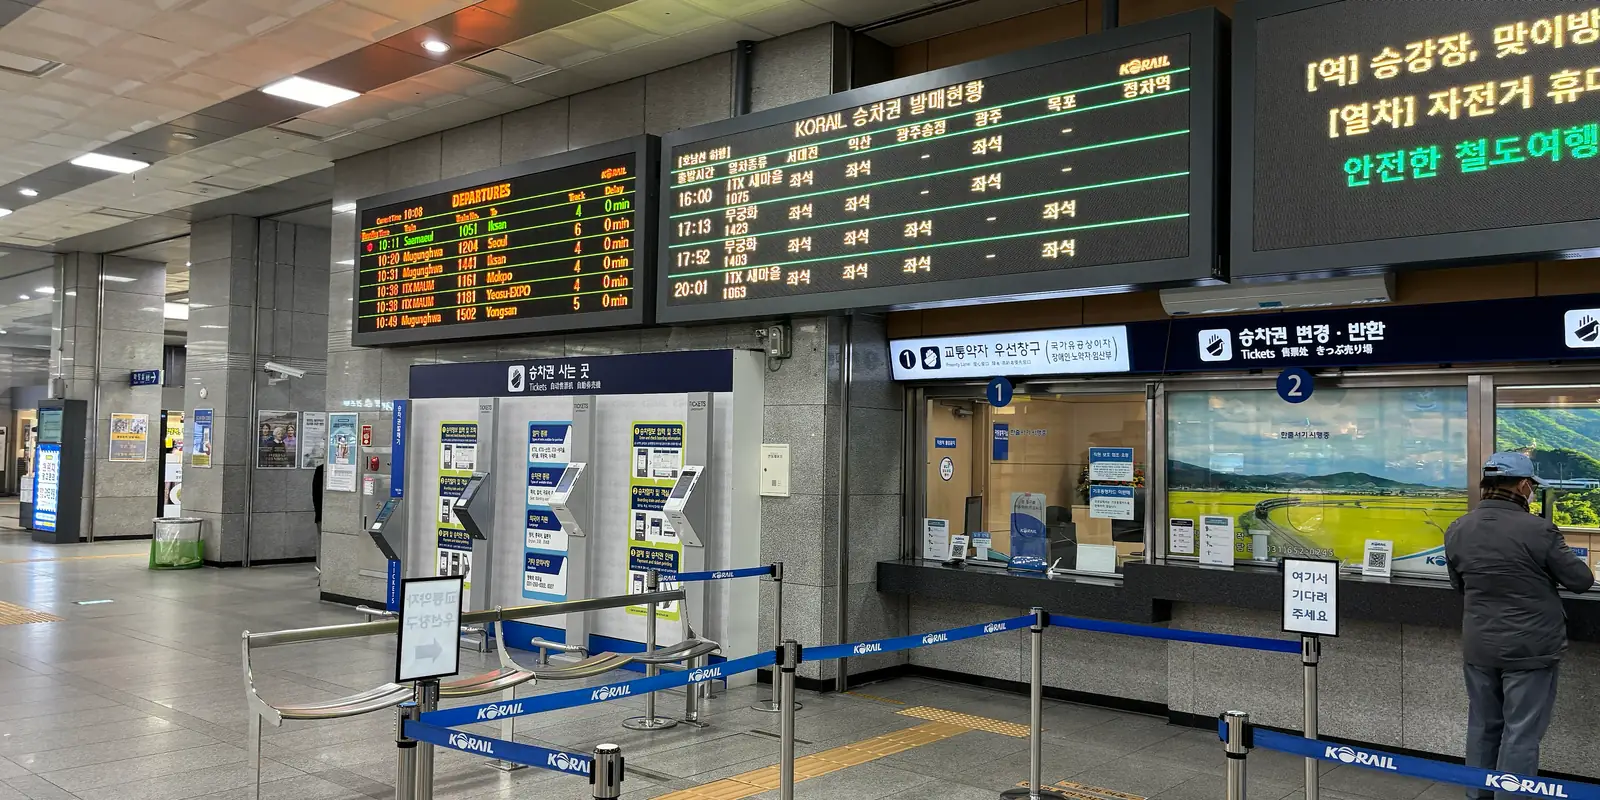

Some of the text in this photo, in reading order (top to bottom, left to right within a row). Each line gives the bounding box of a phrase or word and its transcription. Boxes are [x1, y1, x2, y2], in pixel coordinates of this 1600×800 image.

[1307, 8, 1600, 92] [역] 승강장, 맞이방
[1119, 55, 1170, 76] KORAIL
[795, 80, 984, 137] KORAIL 승차권 발매현황
[1329, 96, 1416, 138] [열차]
[1427, 75, 1534, 120] 자전거
[677, 75, 1171, 184] 출발시간 열차종류 서대전 익산 광주송정 광주 목포 정차역
[1344, 123, 1598, 188] 안전한 철도여행
[601, 166, 627, 179] KORAIL
[679, 135, 1003, 207] 16:00 ITX 새마을 좌석 좌석 좌석
[452, 183, 511, 208] DEPARTURES
[604, 184, 625, 196] Delay
[726, 190, 750, 205] 1075
[404, 206, 423, 220] 10:08
[678, 173, 1002, 237] 17:13 무궁화 좌석 좌석 좌석
[379, 237, 399, 251] 10:11
[459, 223, 478, 237] 1051
[488, 220, 507, 232] Iksan
[575, 204, 582, 217] 4
[605, 199, 612, 212] 0
[613, 198, 630, 211] min
[677, 200, 1076, 267] 17:52 무궁화 좌석 좌석 좌석 좌석
[724, 222, 748, 236] 1423
[378, 217, 629, 267] 10:20 Mugunghwa 1204 Seoul 6 0 min
[377, 236, 629, 282] 10:31 Mugunghwa 1441 Iksan 4 0 min
[674, 239, 1076, 297] 20:01 ITX 새마을 좌석 좌석 좌석 좌석
[724, 254, 748, 268] 1403
[377, 284, 399, 298] 10:38
[457, 274, 476, 288] 1161
[486, 271, 513, 285] Mokpo
[574, 260, 581, 273] 4
[603, 256, 610, 269] 0
[612, 255, 629, 268] min
[376, 299, 398, 313] 10:38
[457, 290, 476, 304] 1181
[486, 285, 531, 301] Yeosu-EXPO
[573, 278, 580, 292] 4
[603, 275, 610, 288] 0
[611, 275, 628, 287] min
[722, 286, 746, 300] 1063
[376, 294, 628, 329] 10:49 Mugunghwa 1502 Yongsan 5 0 min
[1239, 321, 1386, 347] 승차권 변경 반환
[945, 341, 1040, 360] 교통약자 우선창구
[1051, 339, 1111, 351] 국가유공상이자
[1241, 343, 1373, 360] Tickets 售票处 きっぷ売り場
[903, 351, 911, 368] 1
[529, 363, 590, 381] 승차권 사는 곳
[529, 382, 547, 391] Tickets
[995, 383, 1002, 402] 1
[1287, 374, 1303, 397] 2
[657, 574, 677, 582] ORAIL
[711, 571, 734, 580] KORAIL
[1292, 571, 1328, 585] 여기서
[1292, 590, 1328, 603] 기다려
[1292, 608, 1328, 622] 주세요
[984, 622, 1006, 633] KORAIL
[853, 642, 882, 654] KORAIL
[922, 633, 948, 644] KORAIL
[688, 666, 722, 682] KORAIL
[591, 684, 631, 701] KORAIL
[477, 702, 524, 720] KORAIL
[449, 733, 494, 755] KORAIL
[547, 752, 590, 774] KORAI
[1325, 746, 1397, 770] KORAIL
[1485, 773, 1568, 799] KORAIL
